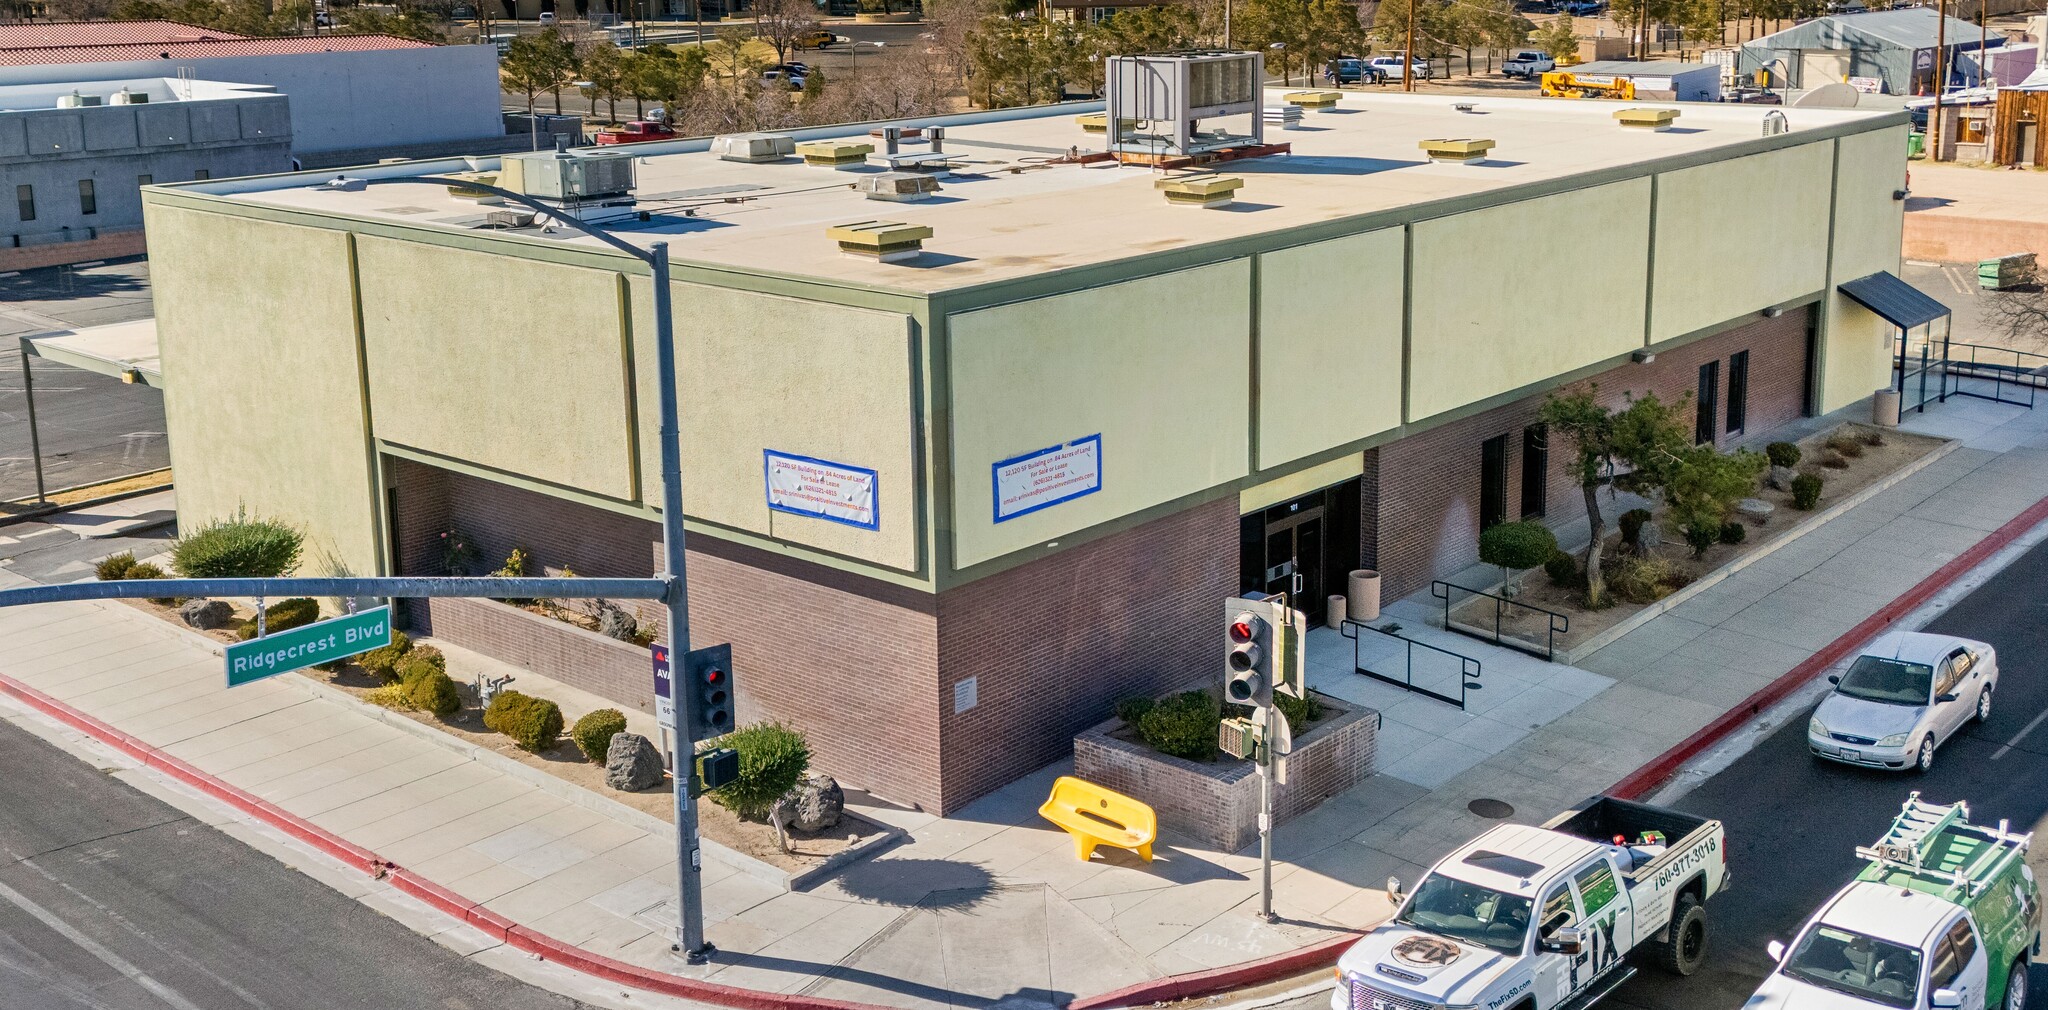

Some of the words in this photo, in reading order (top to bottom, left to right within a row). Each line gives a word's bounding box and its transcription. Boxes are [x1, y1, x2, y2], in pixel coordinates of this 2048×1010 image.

[798, 464, 817, 476] Building
[833, 470, 846, 480] Acres
[1005, 468, 1020, 477] 12,120
[1028, 460, 1046, 470] Building
[1061, 452, 1074, 460] Acres
[1080, 445, 1090, 454] Land
[1038, 468, 1048, 476] Sale
[1055, 463, 1068, 471] Lease
[1290, 503, 1298, 512] 101
[234, 633, 336, 673] Ridgecrest
[345, 620, 384, 644] Blvd
[1653, 836, 1716, 891] 760-977-3018
[1488, 979, 1532, 1010] TheFixSD.com
